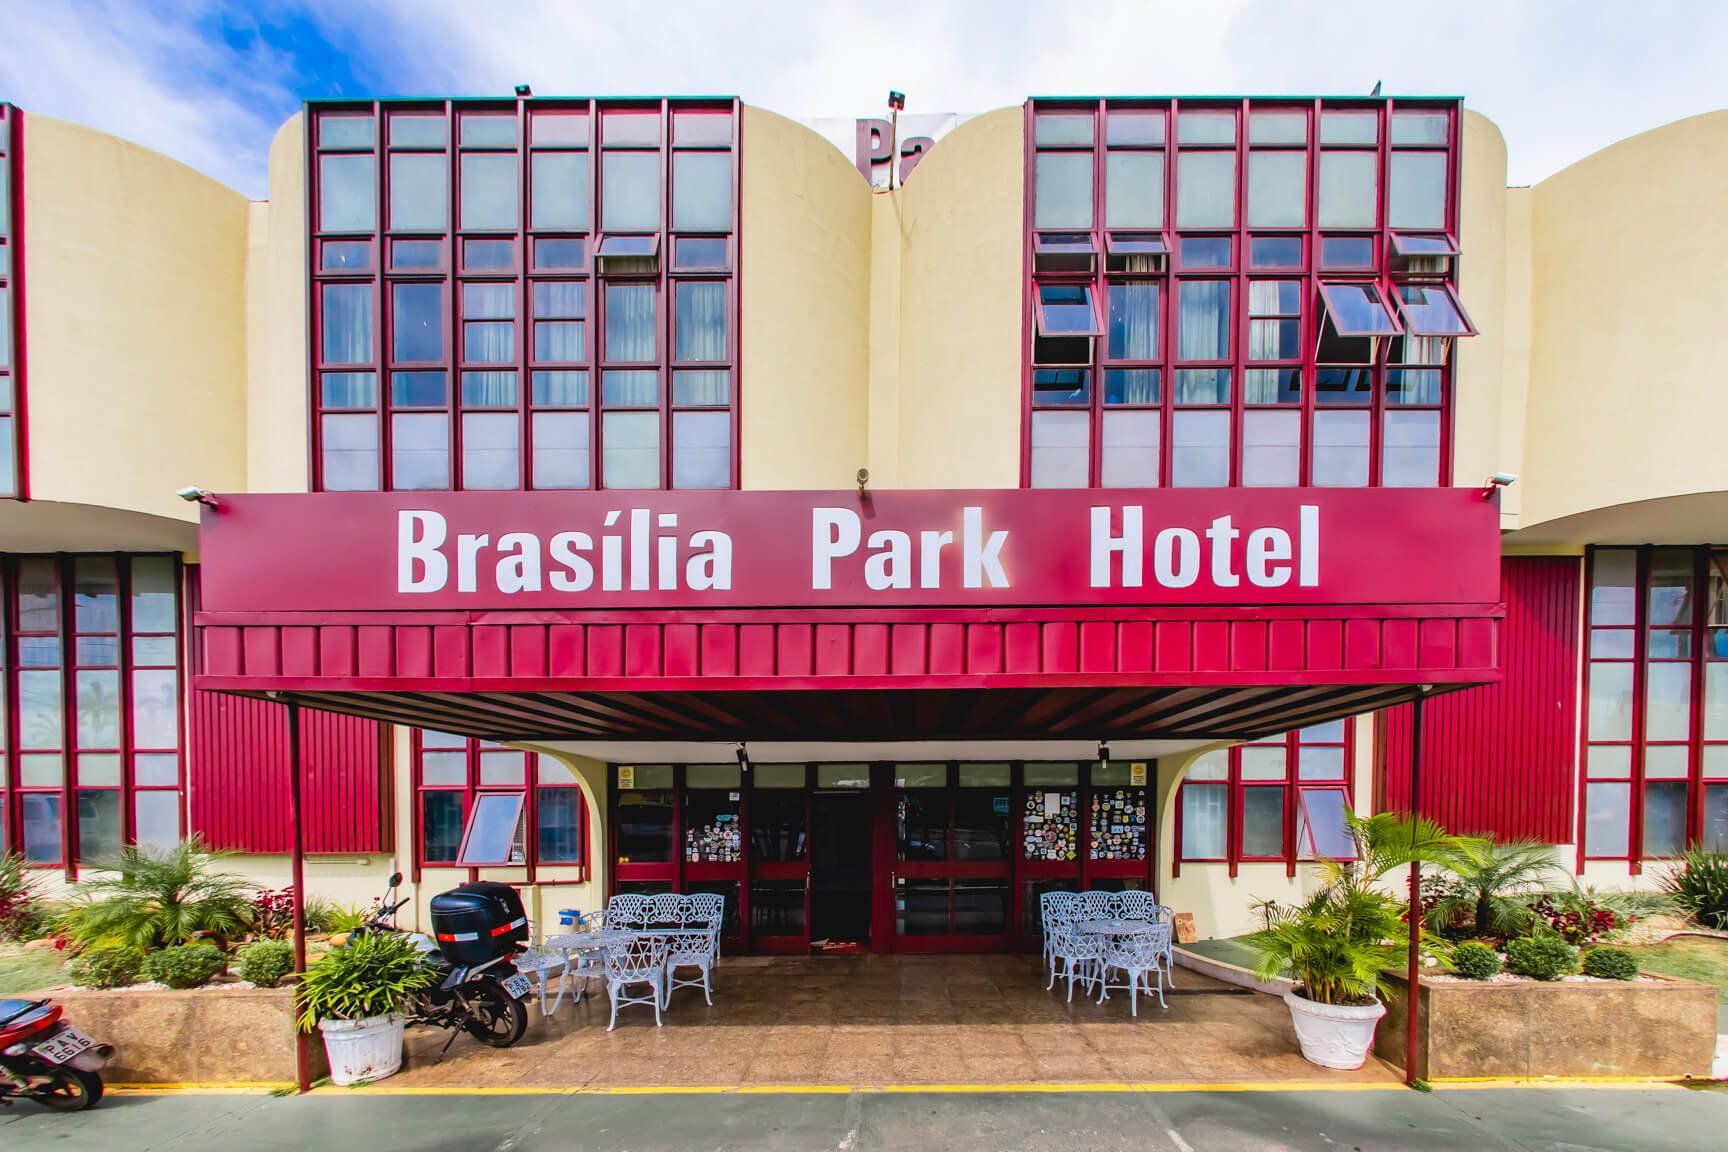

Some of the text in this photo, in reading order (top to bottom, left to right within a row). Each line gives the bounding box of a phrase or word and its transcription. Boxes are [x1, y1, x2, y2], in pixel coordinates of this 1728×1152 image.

[397, 505, 1319, 594] Brasília Park Hotel
